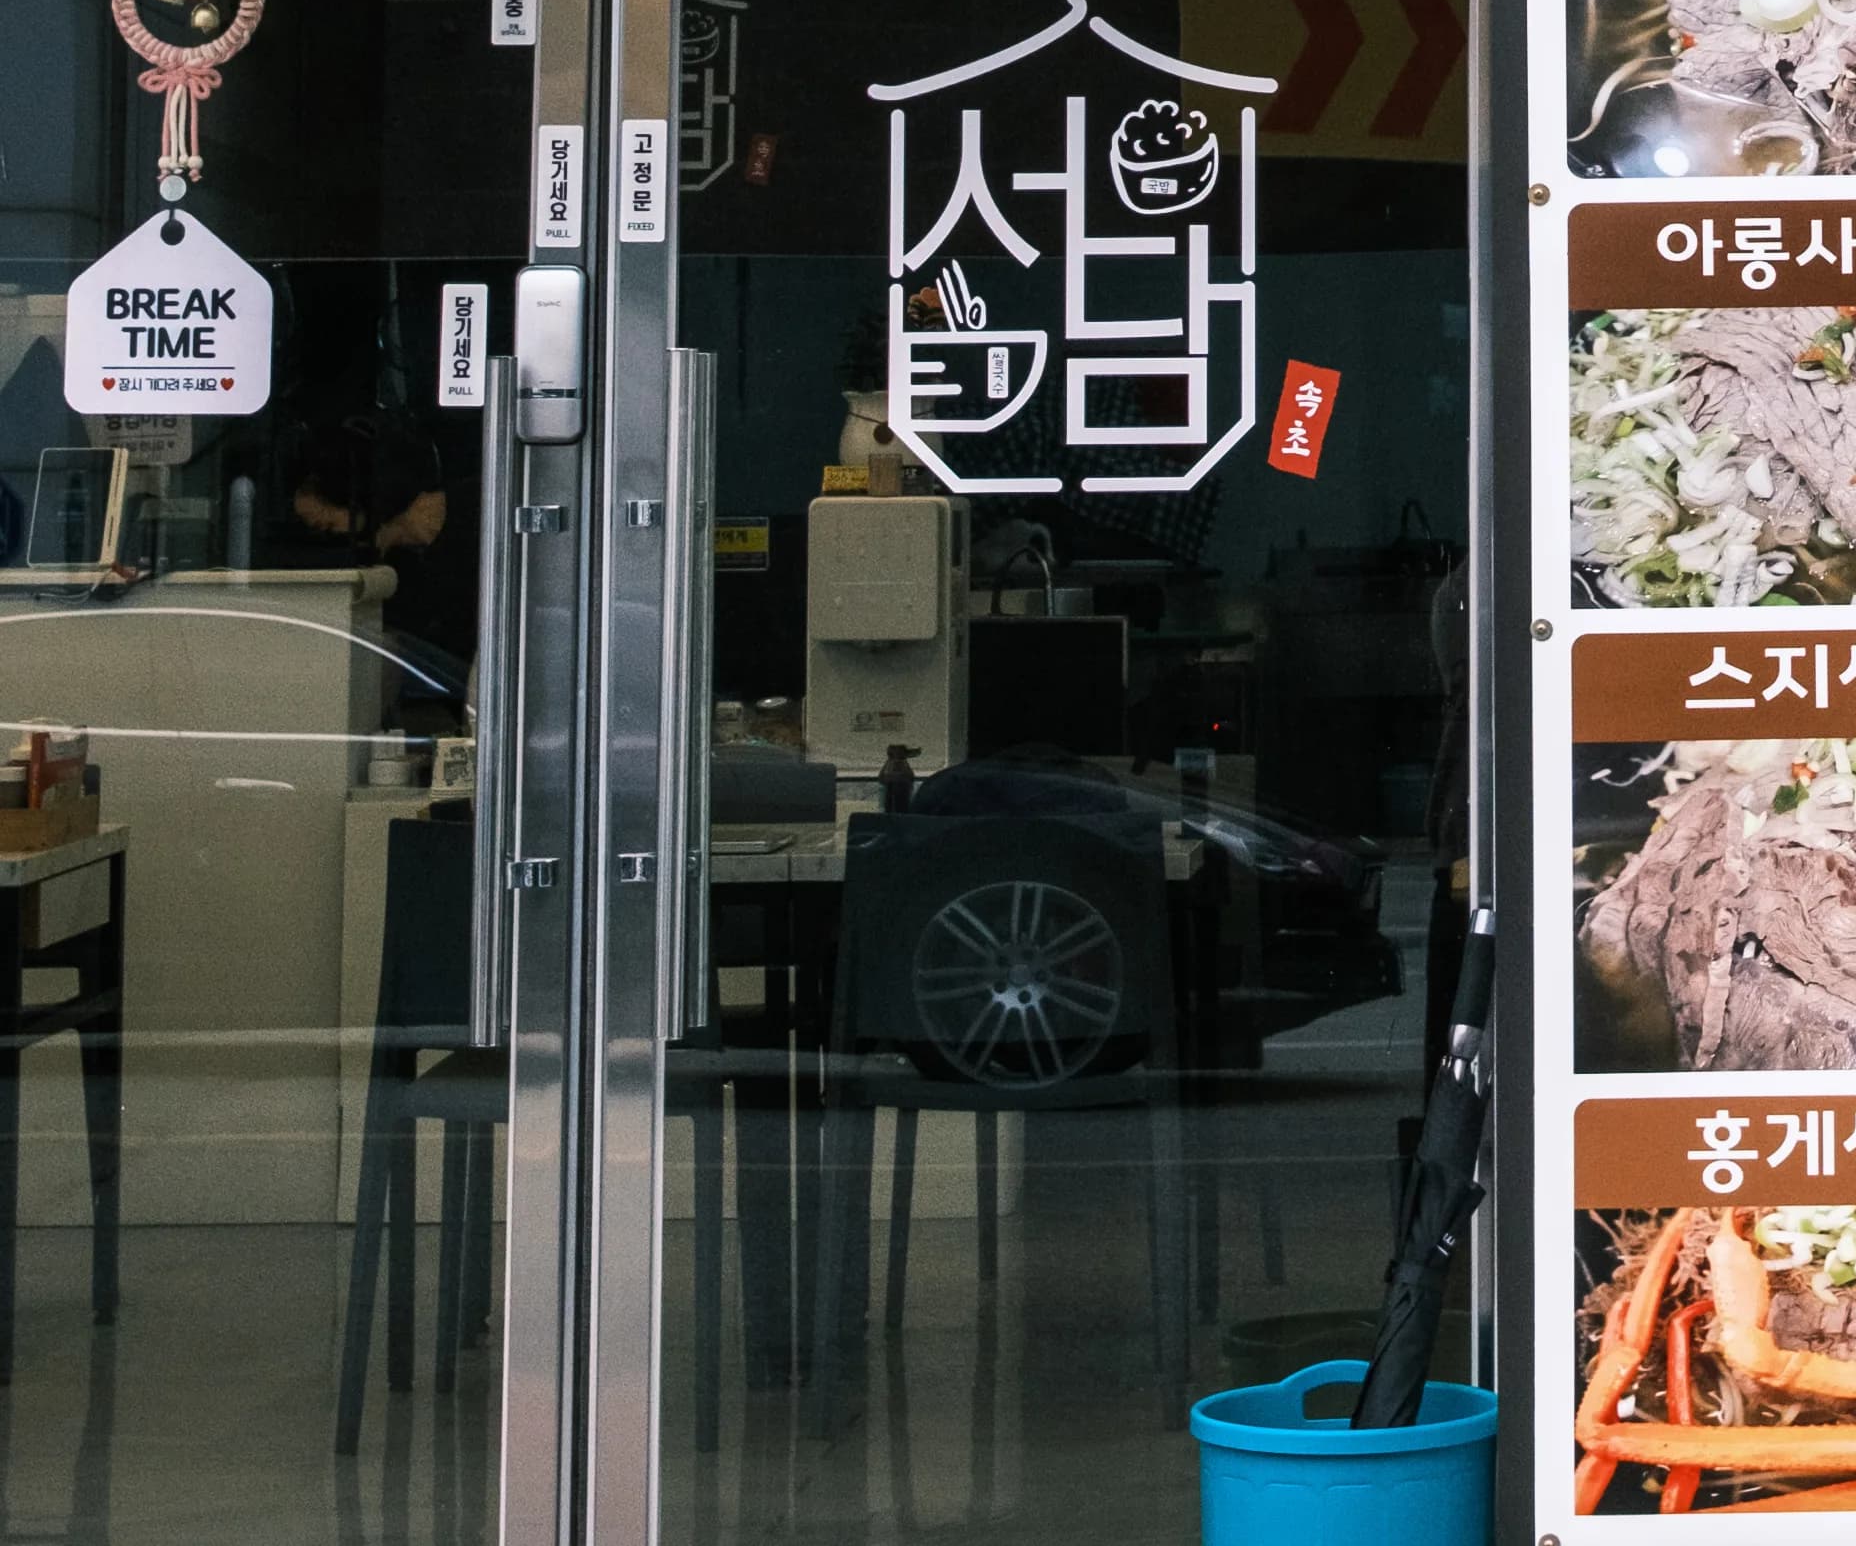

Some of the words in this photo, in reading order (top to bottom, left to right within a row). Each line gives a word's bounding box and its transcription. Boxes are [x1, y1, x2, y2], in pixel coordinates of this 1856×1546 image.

[549, 139, 571, 222] 당기세요
[632, 133, 654, 213] 고정문
[545, 229, 571, 239] PULL
[627, 222, 655, 232] FIXED
[106, 288, 237, 320] BREAK
[121, 326, 217, 359] TIME
[452, 296, 475, 379] 당기세요
[119, 377, 143, 392] 잠시
[146, 377, 180, 392] 기다려
[182, 378, 218, 392] 주세요
[448, 386, 474, 396] PULL
[1280, 378, 1324, 459] 속초
